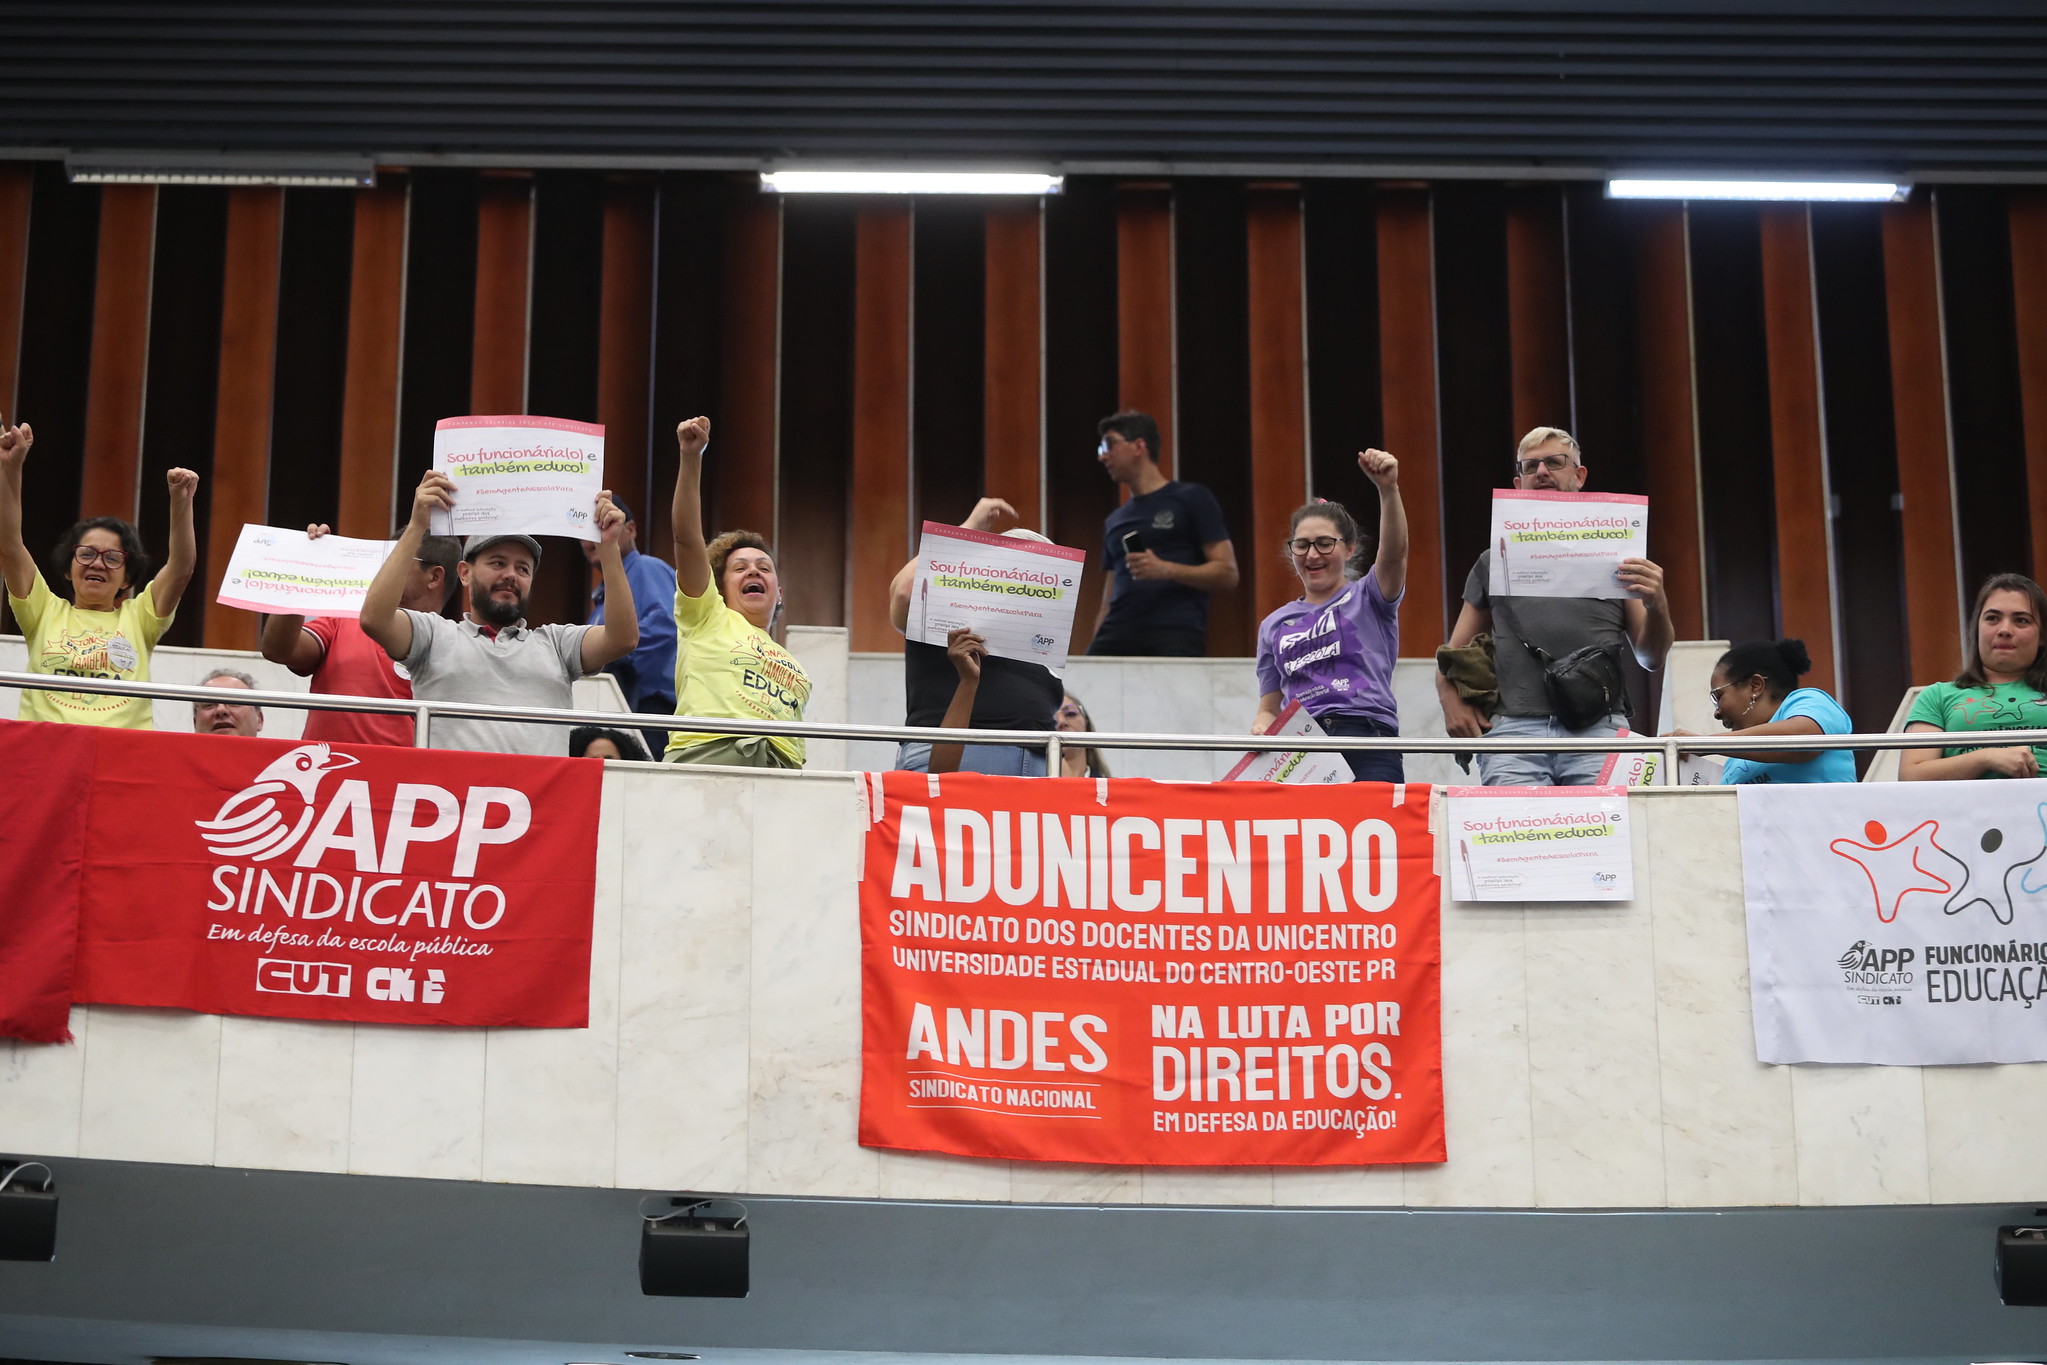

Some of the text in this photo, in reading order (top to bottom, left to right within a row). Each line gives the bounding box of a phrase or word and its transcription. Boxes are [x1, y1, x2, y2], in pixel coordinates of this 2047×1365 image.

[447, 445, 597, 464] Sou funcionária(o) e
[460, 461, 584, 476] também educo!
[572, 510, 588, 520] APP
[1504, 516, 1641, 532] Sou funcionária(o) e
[1516, 529, 1628, 543] também educo!
[248, 569, 367, 588] também educo!
[930, 560, 1073, 587] Sou funcionária(o) e
[940, 574, 1057, 600] também educo!
[1037, 635, 1055, 646] APP
[1304, 723, 1313, 733] e
[293, 779, 532, 878] APP
[1463, 811, 1621, 833] Sou funcionária(o) e
[1479, 824, 1608, 844] também educo!
[890, 805, 1397, 914] ADUNICENTRO
[1599, 873, 1617, 882] APP
[207, 864, 507, 930] SINDICATO
[207, 923, 494, 962] Em defesa da escola pública
[889, 909, 1397, 952] SINDICATO DOS DOCENTES DA UNICENTRO
[892, 945, 1396, 984] UNIVERSIDADE ESTADUAL DO CENTRO-OESTE PR
[1861, 947, 1915, 972] APP
[257, 959, 351, 997] CUT
[1844, 971, 1914, 985] SINDICATO
[1152, 1001, 1401, 1039] NA LUTA POR
[905, 1001, 1108, 1073] ANDES
[1152, 1042, 1402, 1102] DIREITOS.
[909, 1079, 1096, 1109] SINDICATO NACIONAL
[1153, 1106, 1397, 1139] EM DEFESA DA EDUCAÇÃO!
